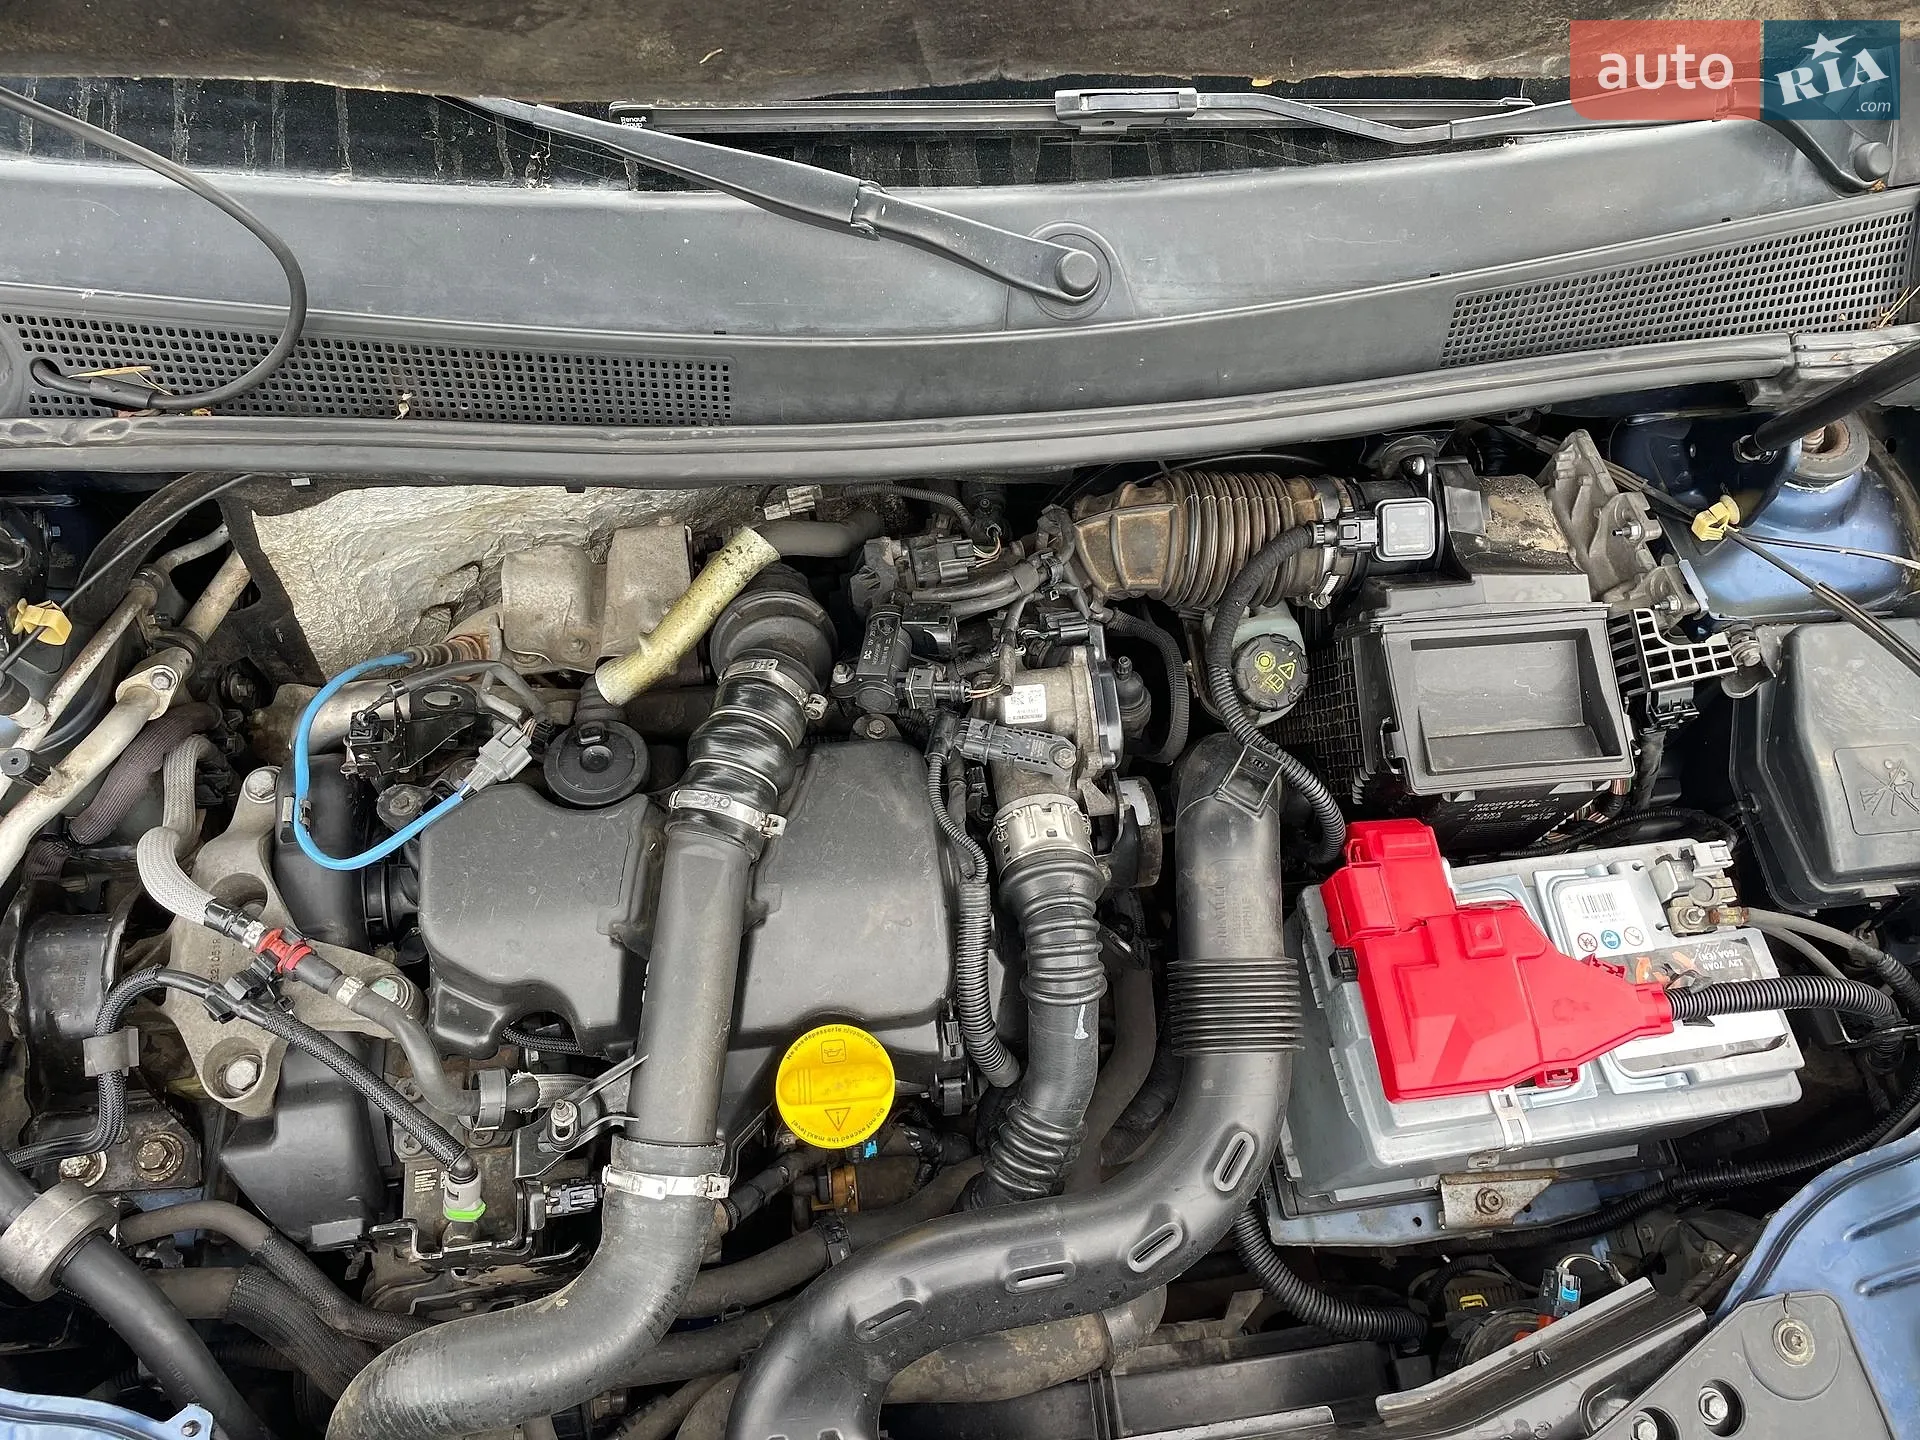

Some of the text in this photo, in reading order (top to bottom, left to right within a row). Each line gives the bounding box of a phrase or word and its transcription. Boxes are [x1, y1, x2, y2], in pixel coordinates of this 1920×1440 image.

[1702, 960, 1725, 971] 70Ah
[876, 1107, 885, 1117] Do
[841, 1127, 866, 1142] exceed
